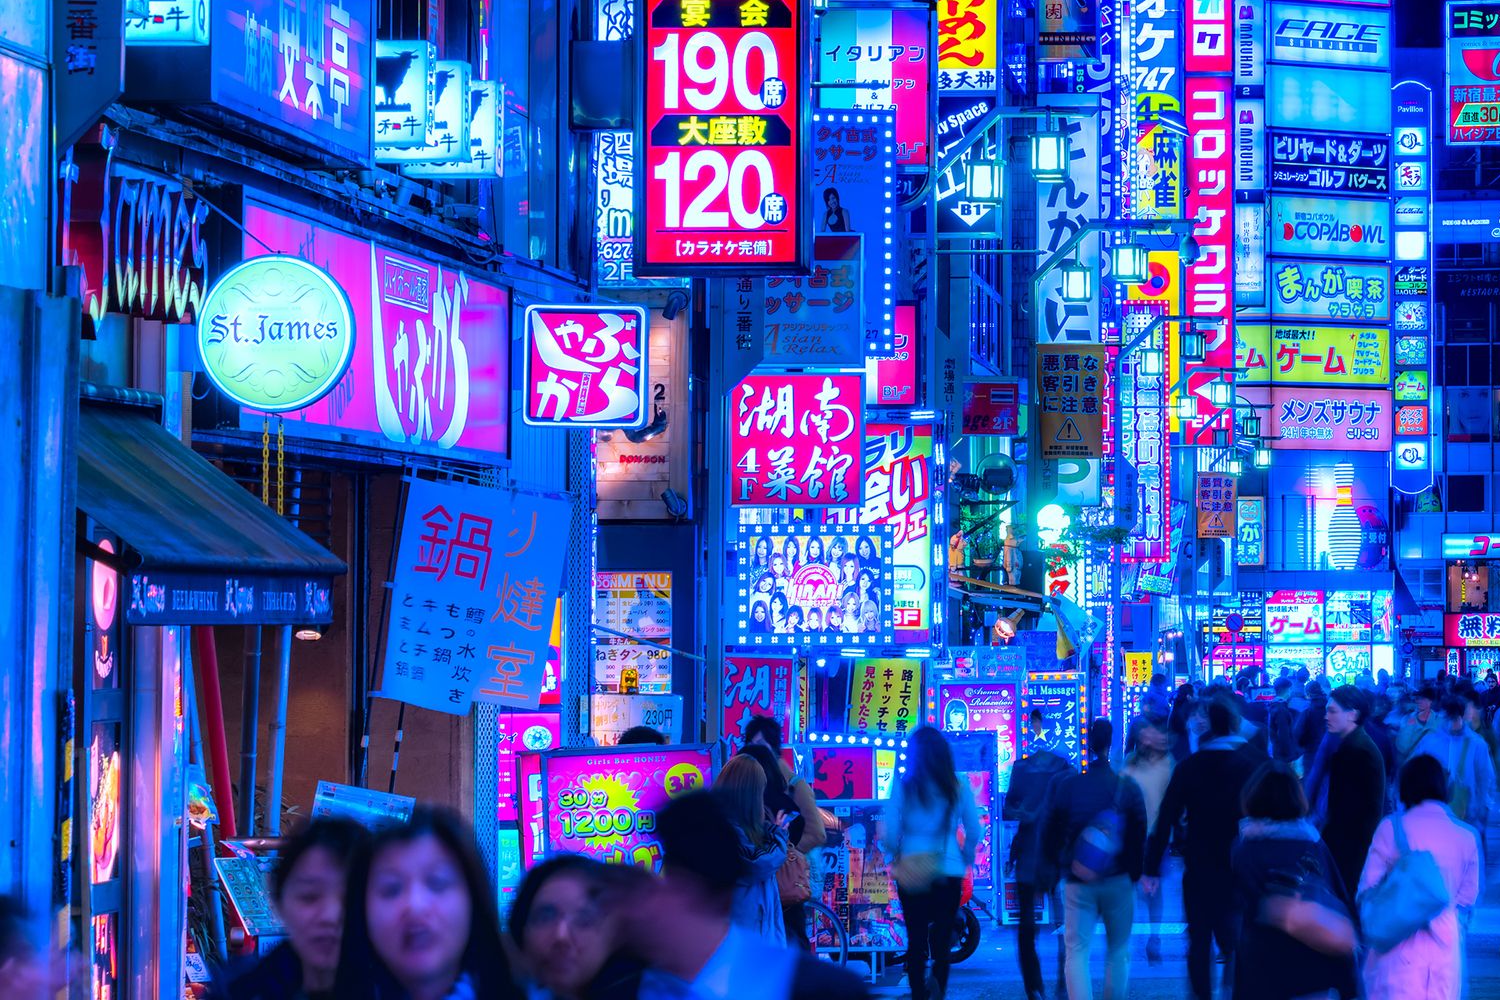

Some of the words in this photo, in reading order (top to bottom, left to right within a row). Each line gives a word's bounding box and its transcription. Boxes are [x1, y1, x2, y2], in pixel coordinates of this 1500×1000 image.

[1275, 18, 1386, 42] FACE
[825, 45, 926, 62] イタリアン
[1239, 23, 1254, 77] MARUHAN
[1289, 38, 1364, 52] SHINJUKU
[1397, 104, 1424, 113] Pavilion
[677, 115, 767, 146] 大座敷
[1239, 128, 1254, 182] MARUHAN
[1273, 136, 1387, 166] ビリヤード&ダーツ
[1153, 130, 1179, 208] 麻雀
[1347, 173, 1388, 191] バグース
[960, 204, 981, 216] B1
[1294, 212, 1334, 222] 新宿コパボウル
[1278, 264, 1385, 302] まんが喫茶
[1274, 329, 1316, 340] 地域最大!!
[1042, 353, 1100, 372] 悪質な
[1276, 343, 1347, 375] ゲーム
[1042, 374, 1099, 393] 客引き
[738, 378, 855, 444] 湖南
[1042, 395, 1100, 414] に注意
[1280, 398, 1382, 426] メンズサウナ
[1280, 428, 1300, 440] 24H
[1300, 427, 1334, 440] 年中無休
[762, 445, 854, 504] 菜館
[413, 504, 493, 591] 鍋
[617, 574, 669, 589] MENU
[432, 602, 460, 666] もつ鍋
[1269, 614, 1322, 635] ゲーム
[1330, 650, 1370, 672] まんが
[1039, 685, 1076, 697] Massage
[969, 697, 1014, 707] Relaxation
[586, 757, 612, 766] Girls
[633, 755, 668, 764] HONEY
[668, 772, 698, 794] 3F
